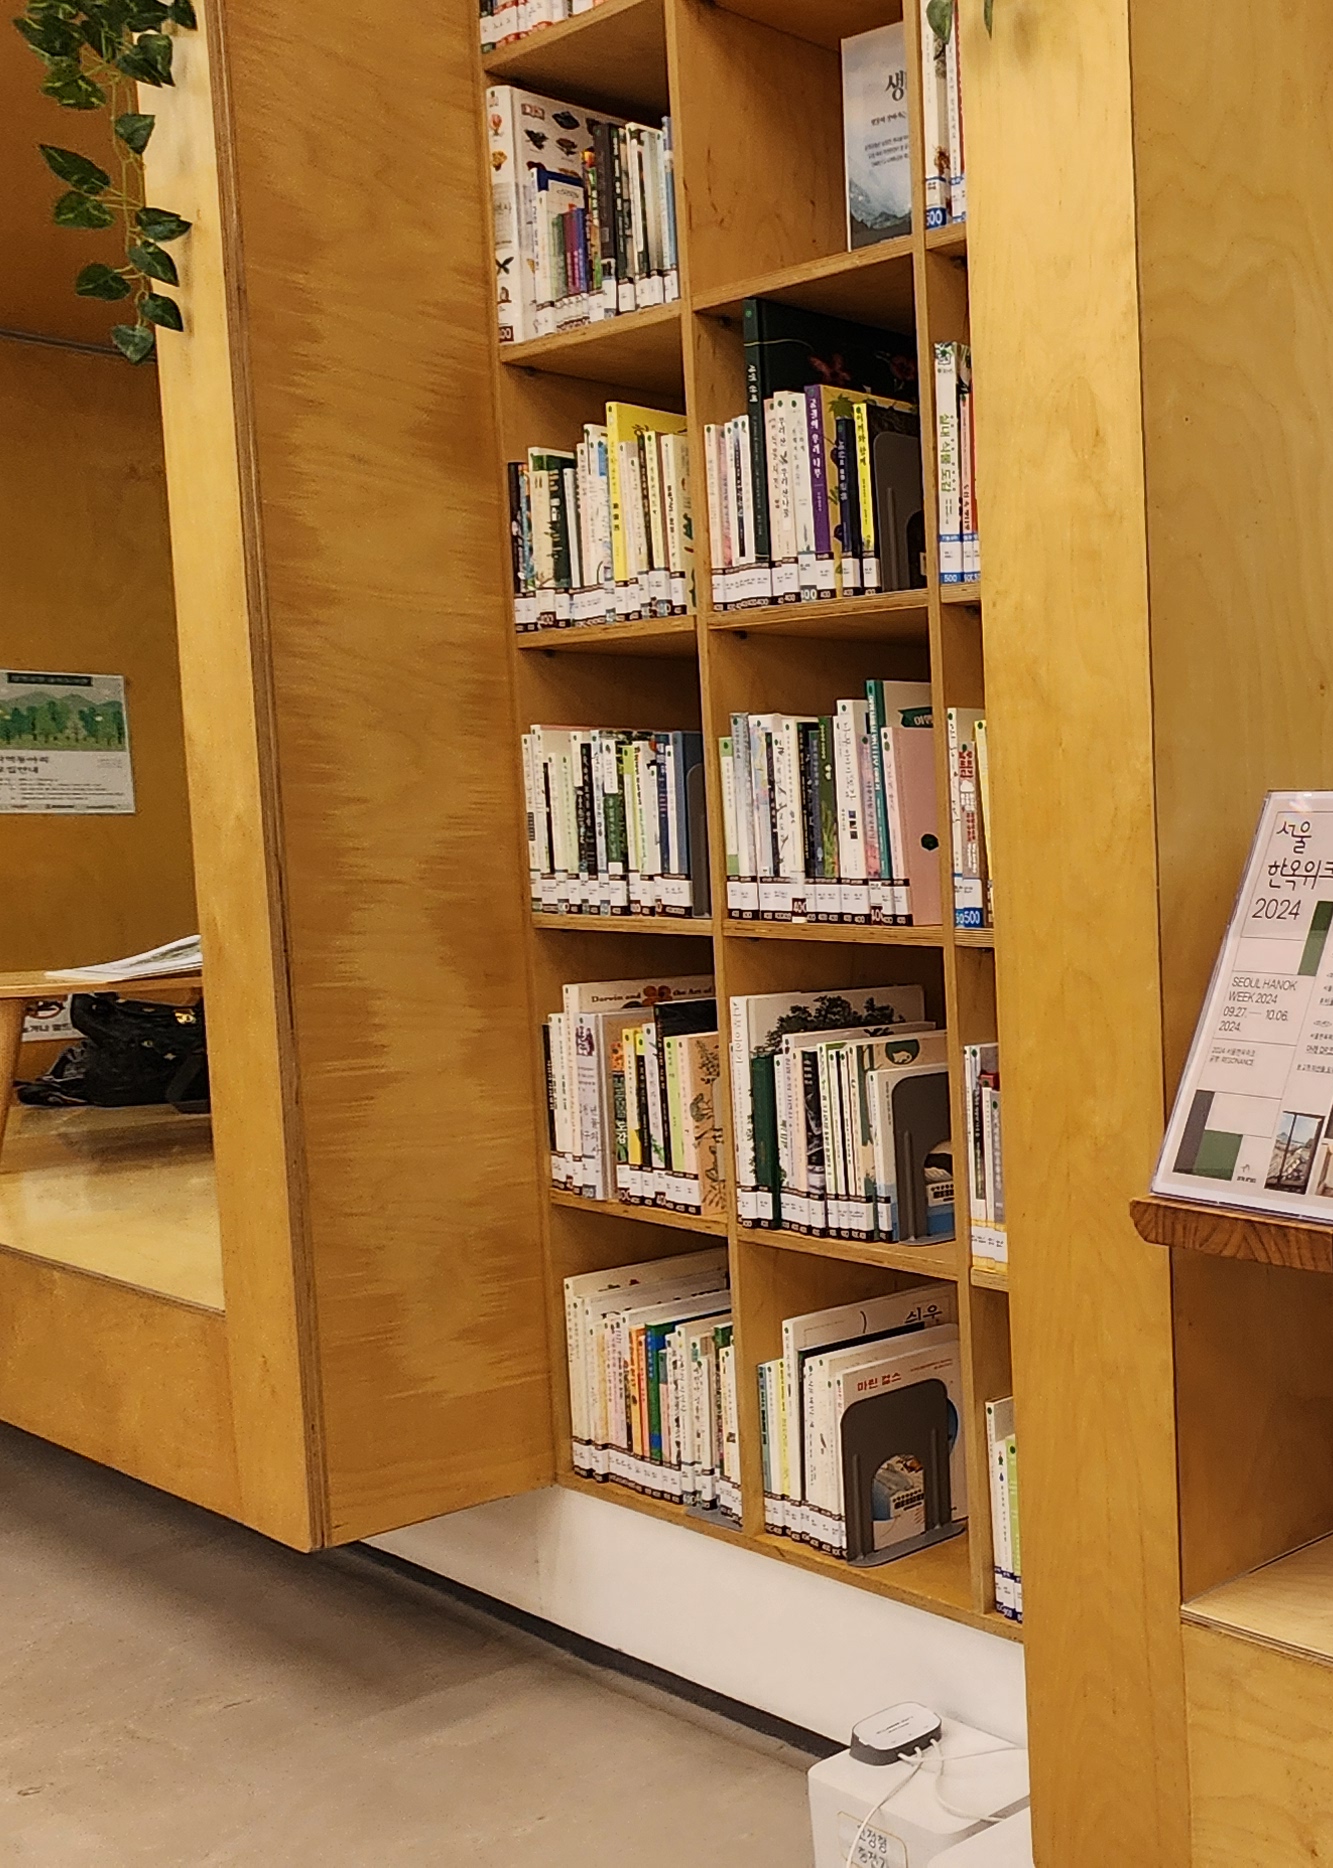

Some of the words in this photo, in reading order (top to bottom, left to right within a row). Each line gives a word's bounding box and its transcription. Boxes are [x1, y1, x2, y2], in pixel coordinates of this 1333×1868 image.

[1276, 820, 1312, 855] 서울
[963, 909, 980, 924] 500
[1251, 897, 1302, 921] 2024
[1231, 976, 1261, 990] SEOUL
[1262, 978, 1298, 992] HANOK
[591, 994, 623, 1003] Darwin
[625, 992, 641, 1000] and
[1228, 990, 1254, 1003] WEEK
[1254, 992, 1278, 1005] 2024
[1223, 1005, 1247, 1019] 09.27.
[1265, 1008, 1289, 1022] 10.06.
[1218, 1020, 1241, 1033] 2024.
[857, 1376, 879, 1392] 마린
